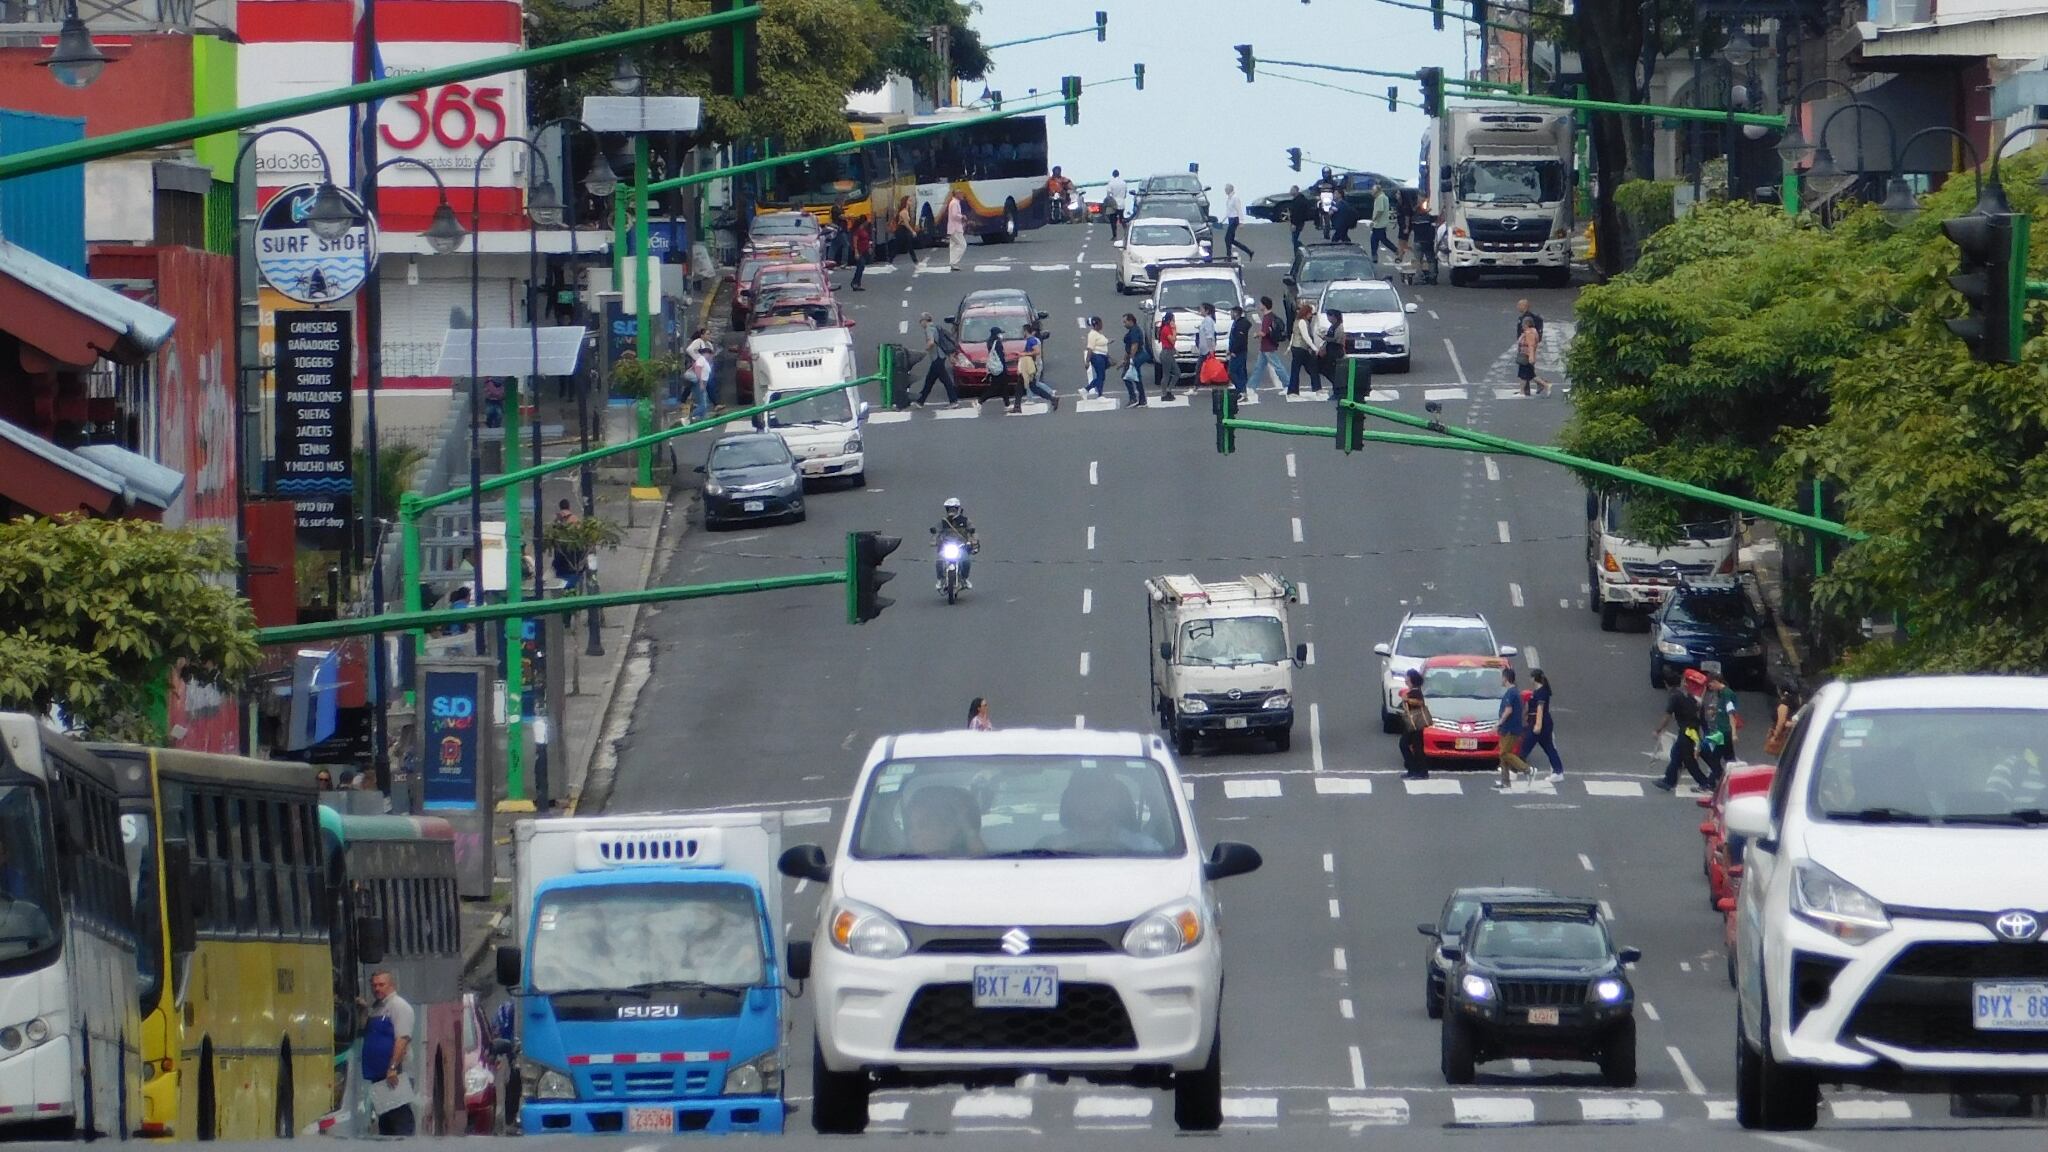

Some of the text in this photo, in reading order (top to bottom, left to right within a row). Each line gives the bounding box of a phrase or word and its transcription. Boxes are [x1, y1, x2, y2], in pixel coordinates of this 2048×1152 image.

[379, 84, 506, 150] 365
[263, 233, 367, 253] SURF SHOP
[290, 322, 338, 333] CAMISETAS
[288, 337, 340, 351] BAÑADORES
[294, 356, 334, 368] JOGGERS
[297, 374, 331, 385] SHORTS
[287, 391, 342, 403] PANTALONES
[297, 408, 331, 420] SUETAS
[296, 425, 333, 437] JACKETS
[298, 443, 331, 456] TENNIS
[285, 461, 292, 472] Y
[293, 461, 325, 473] MUCHO
[432, 696, 472, 717] SJO
[977, 976, 1054, 996] BXT-473
[618, 1005, 680, 1018] ISUZU
